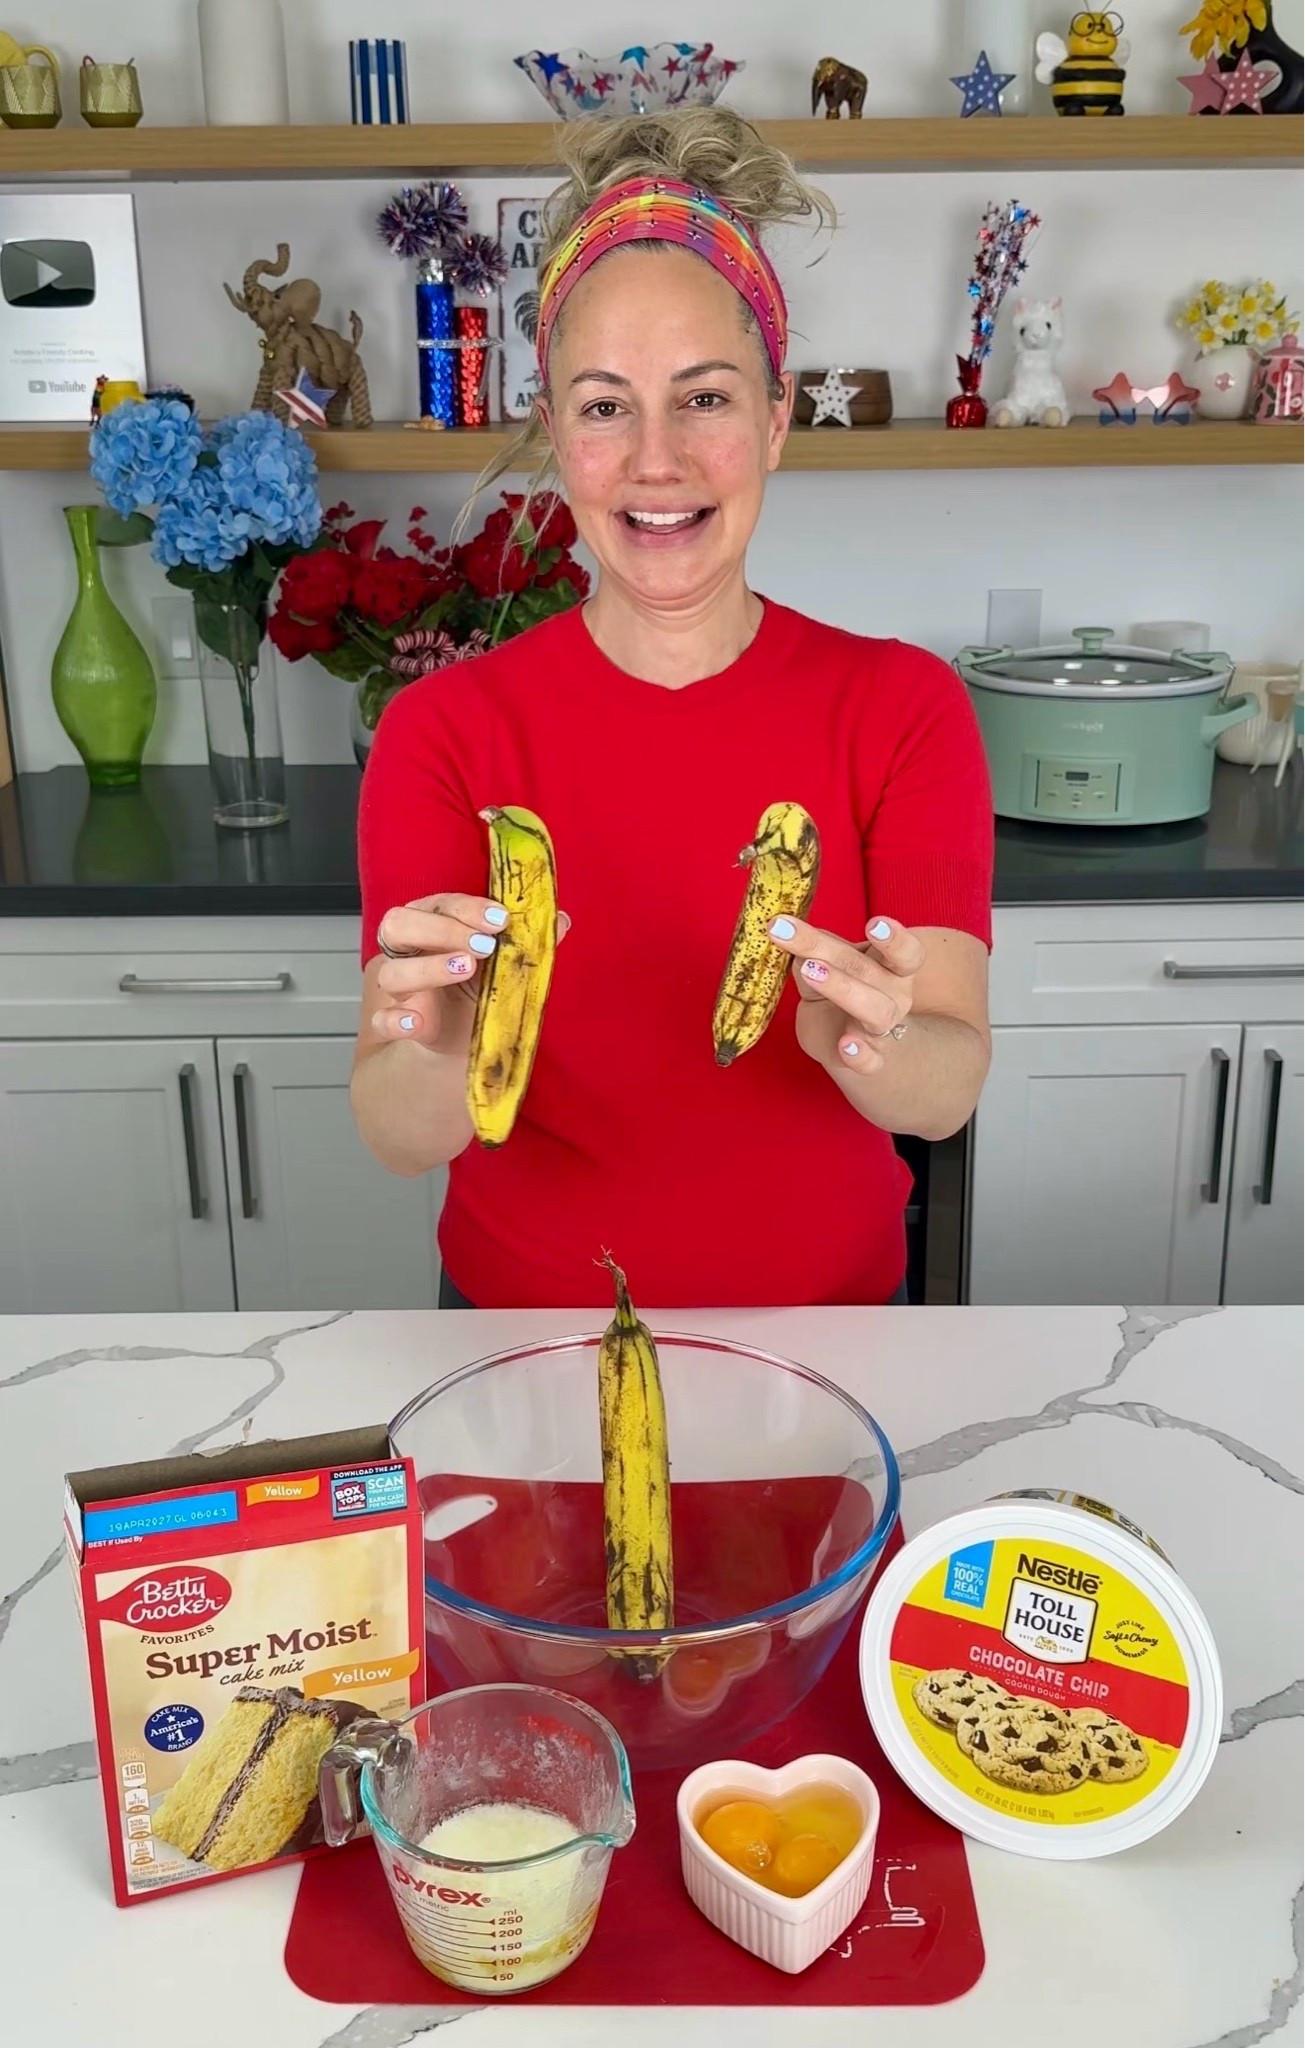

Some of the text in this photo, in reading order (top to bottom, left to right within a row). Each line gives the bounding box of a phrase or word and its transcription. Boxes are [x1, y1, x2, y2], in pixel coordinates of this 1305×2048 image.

[48, 381, 86, 393] YouTube
[333, 1468, 374, 1478] DOWNLOAD
[368, 1475, 404, 1489] SCAN
[264, 1485, 302, 1496] Yellow
[335, 1485, 361, 1500] BOX
[340, 1494, 366, 1506] TOPS
[115, 1537, 133, 1545] Used
[953, 1567, 984, 1586] 100%
[134, 1576, 207, 1604] Betty
[953, 1580, 980, 1596] REAL
[126, 1597, 224, 1624] Crocker
[1029, 1592, 1077, 1621] TOLL
[1014, 1608, 1084, 1643] HOUSE
[1116, 1620, 1145, 1631] JUST LIKE
[140, 1624, 215, 1645] FAVORITES
[1103, 1630, 1123, 1642] Soft
[1129, 1633, 1158, 1647] Chewy
[146, 1618, 373, 1679] Super Moist
[219, 1657, 305, 1686] cake mix
[332, 1666, 393, 1686] Yellow
[969, 1645, 1109, 1699] CHOCOLATE CHIP
[1004, 1678, 1066, 1701] COOKIE DOUGH
[151, 1708, 171, 1722] CAKE
[150, 1716, 199, 1737] America's
[167, 1728, 186, 1742] #1
[167, 1737, 193, 1750] BRAND
[125, 1764, 144, 1776] 160
[392, 1863, 485, 1908] pyrex
[419, 1896, 450, 1912] metric
[498, 1915, 523, 1926] 250
[499, 1928, 523, 1938] 200
[499, 1942, 522, 1951] 150
[499, 1957, 522, 1967] 100
[499, 1973, 514, 1981] 50
